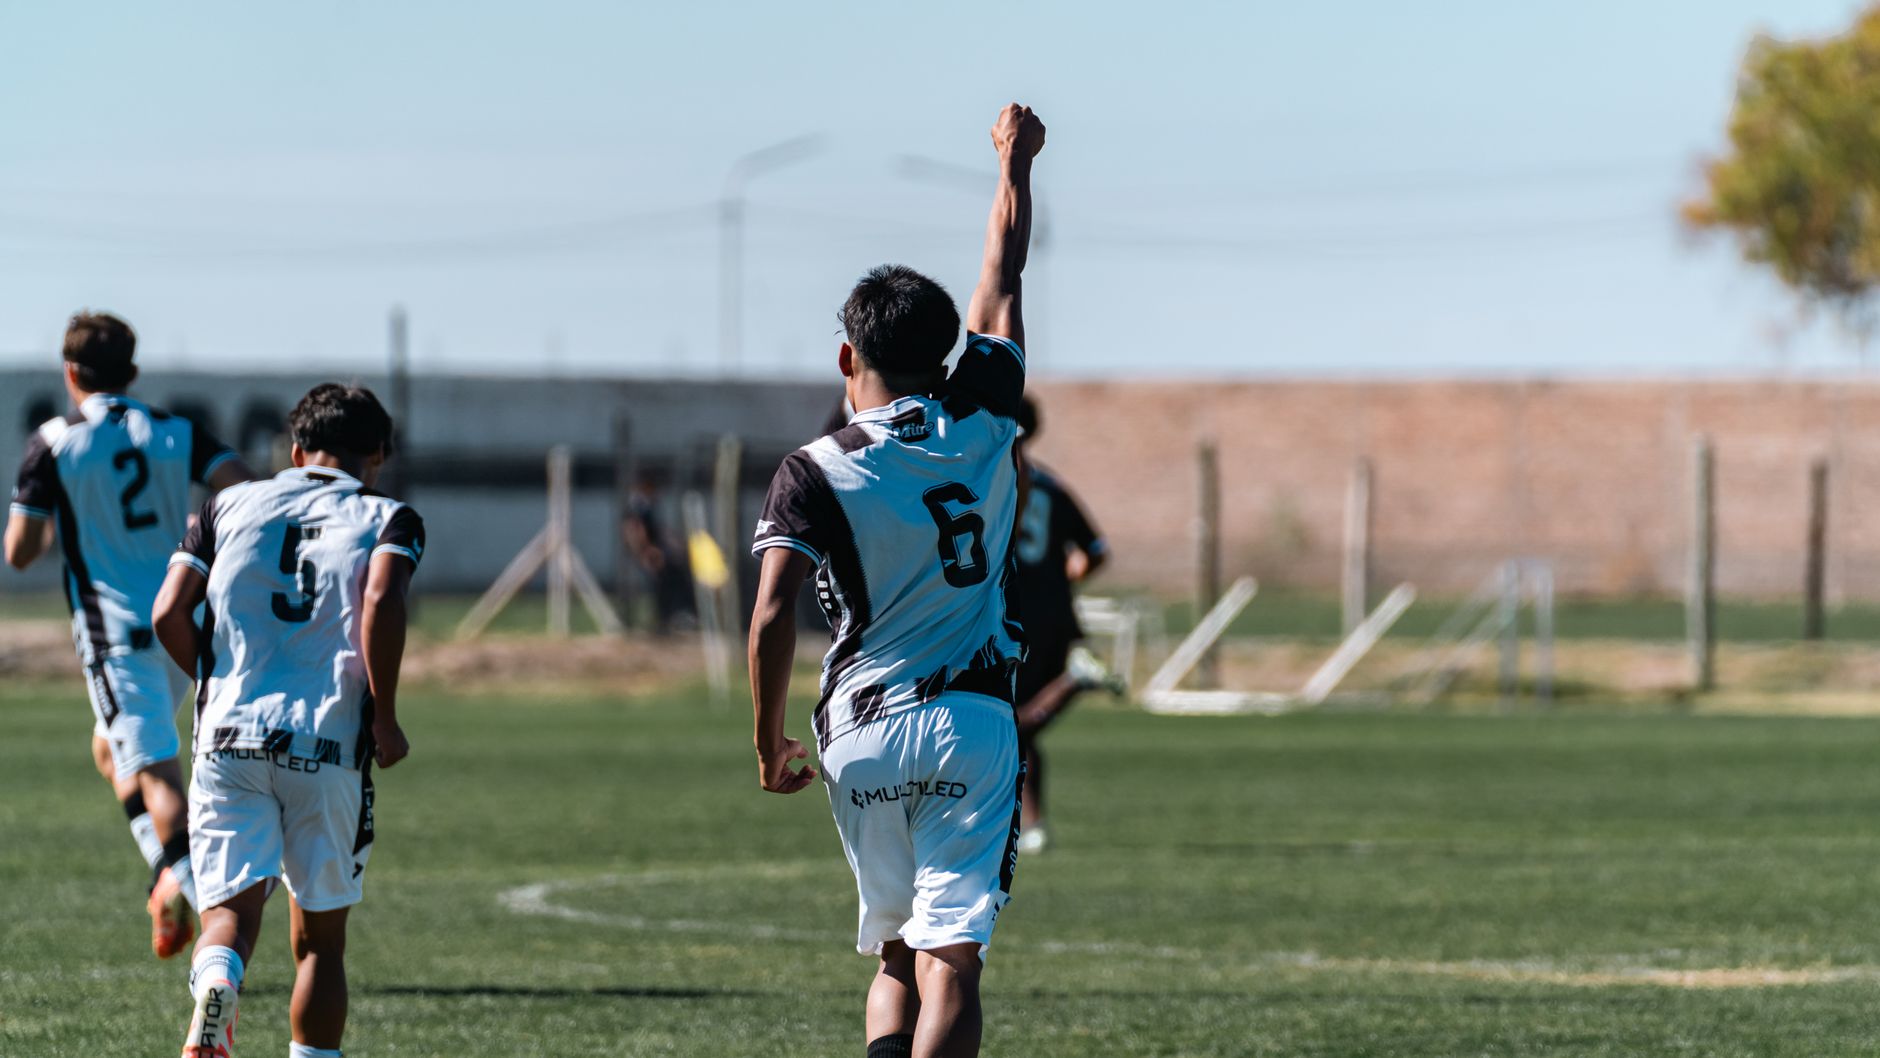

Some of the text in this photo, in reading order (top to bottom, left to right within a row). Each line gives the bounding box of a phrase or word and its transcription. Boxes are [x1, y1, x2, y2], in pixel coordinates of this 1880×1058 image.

[112, 447, 159, 530] 2
[271, 522, 324, 622] 5
[923, 481, 990, 588] 6
[199, 988, 224, 1058] ATOR
